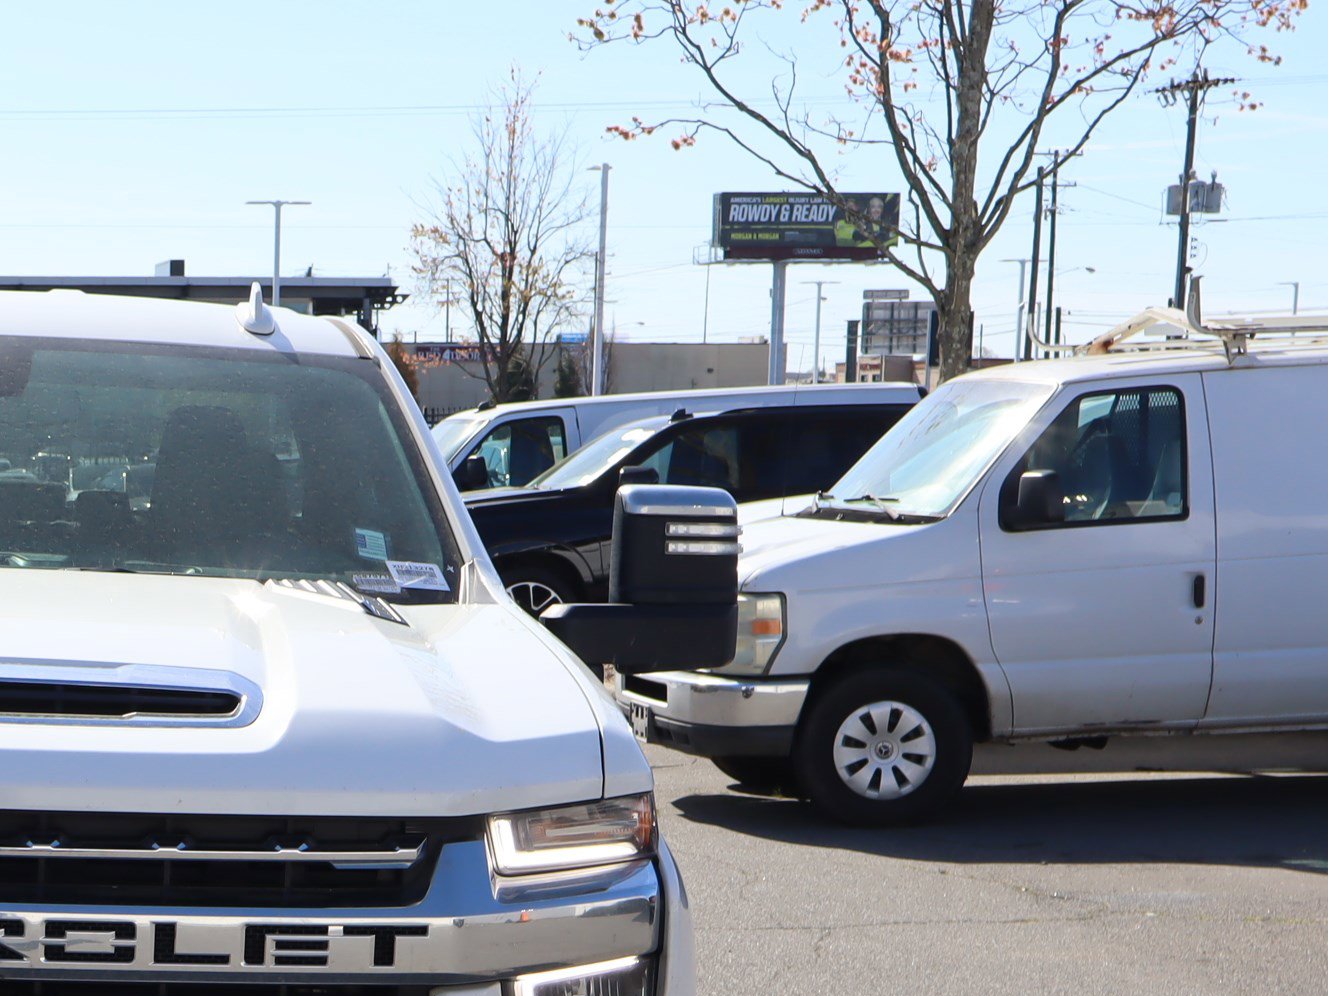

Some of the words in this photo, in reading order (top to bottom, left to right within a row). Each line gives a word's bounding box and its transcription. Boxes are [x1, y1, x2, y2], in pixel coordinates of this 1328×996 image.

[729, 204, 779, 222] ROWDY
[779, 204, 790, 222] &
[792, 204, 837, 222] READY
